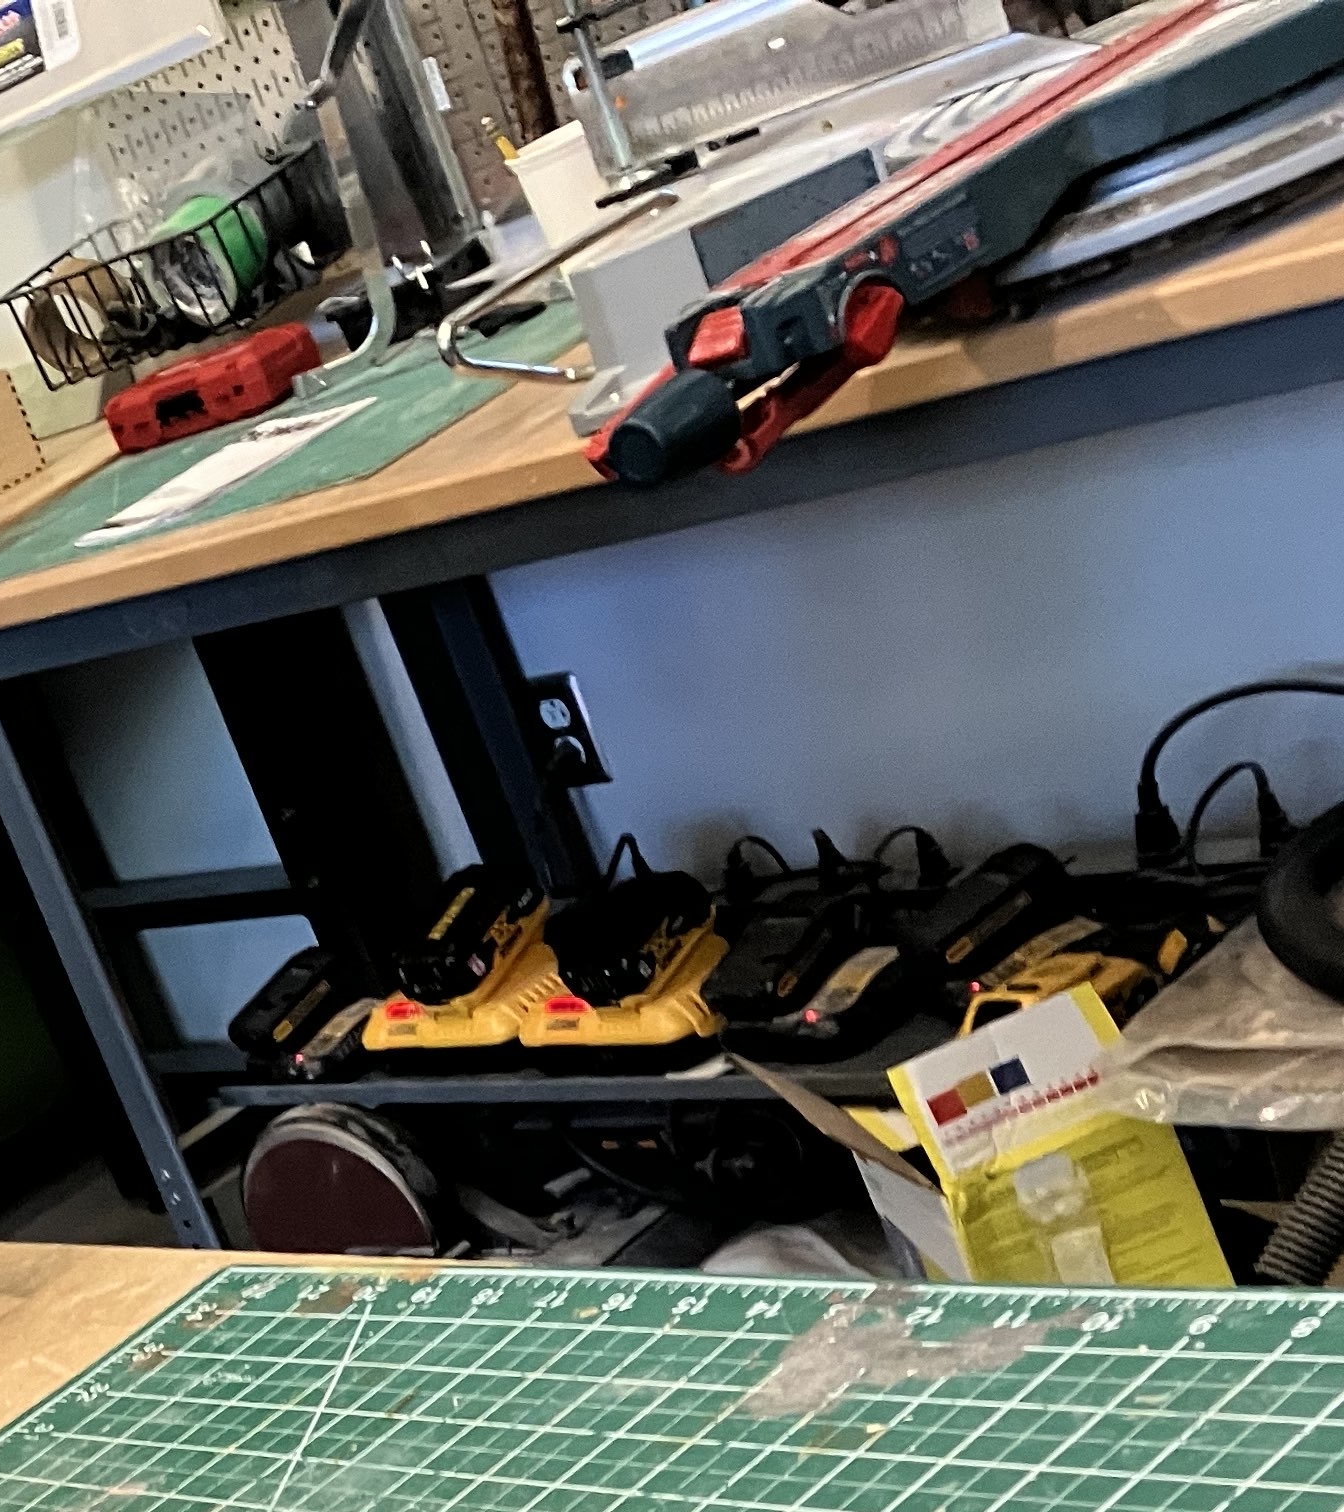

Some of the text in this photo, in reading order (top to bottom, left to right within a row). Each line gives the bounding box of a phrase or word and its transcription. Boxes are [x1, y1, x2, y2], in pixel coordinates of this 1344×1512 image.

[472, 1288, 504, 1305] 18
[534, 1290, 568, 1308] 17
[602, 1292, 637, 1311] 16
[672, 1295, 708, 1315] 15
[745, 1300, 782, 1319] 14
[993, 1310, 1031, 1329] 11
[1082, 1311, 1123, 1332] 10
